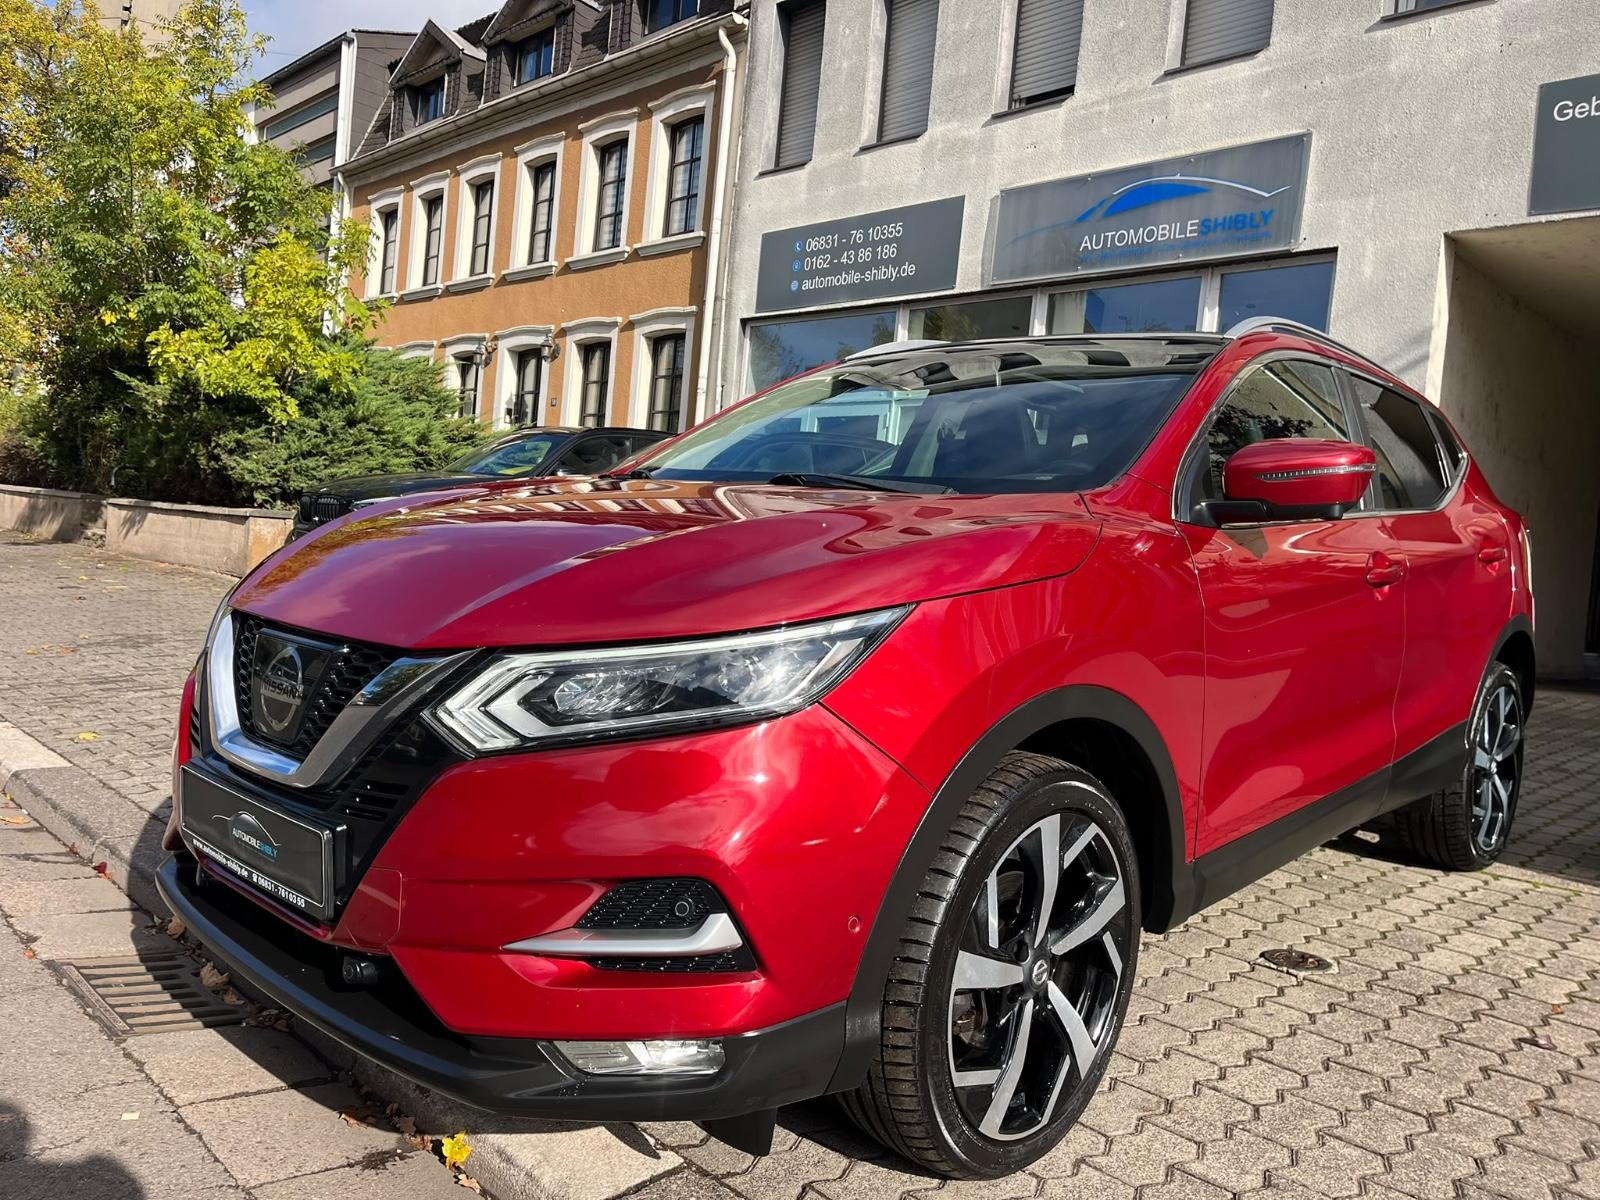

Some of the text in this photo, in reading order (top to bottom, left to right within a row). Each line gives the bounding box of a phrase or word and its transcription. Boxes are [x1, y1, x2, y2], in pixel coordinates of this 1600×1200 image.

[805, 234, 838, 252] 06831
[850, 229, 863, 245] 76
[868, 222, 903, 241] 10355
[804, 254, 831, 271] 0162
[840, 250, 854, 265] 43
[857, 247, 872, 262] 86
[876, 243, 897, 260] 186
[801, 261, 916, 290] automobile-shibly.de
[263, 679, 302, 700] NISSAN
